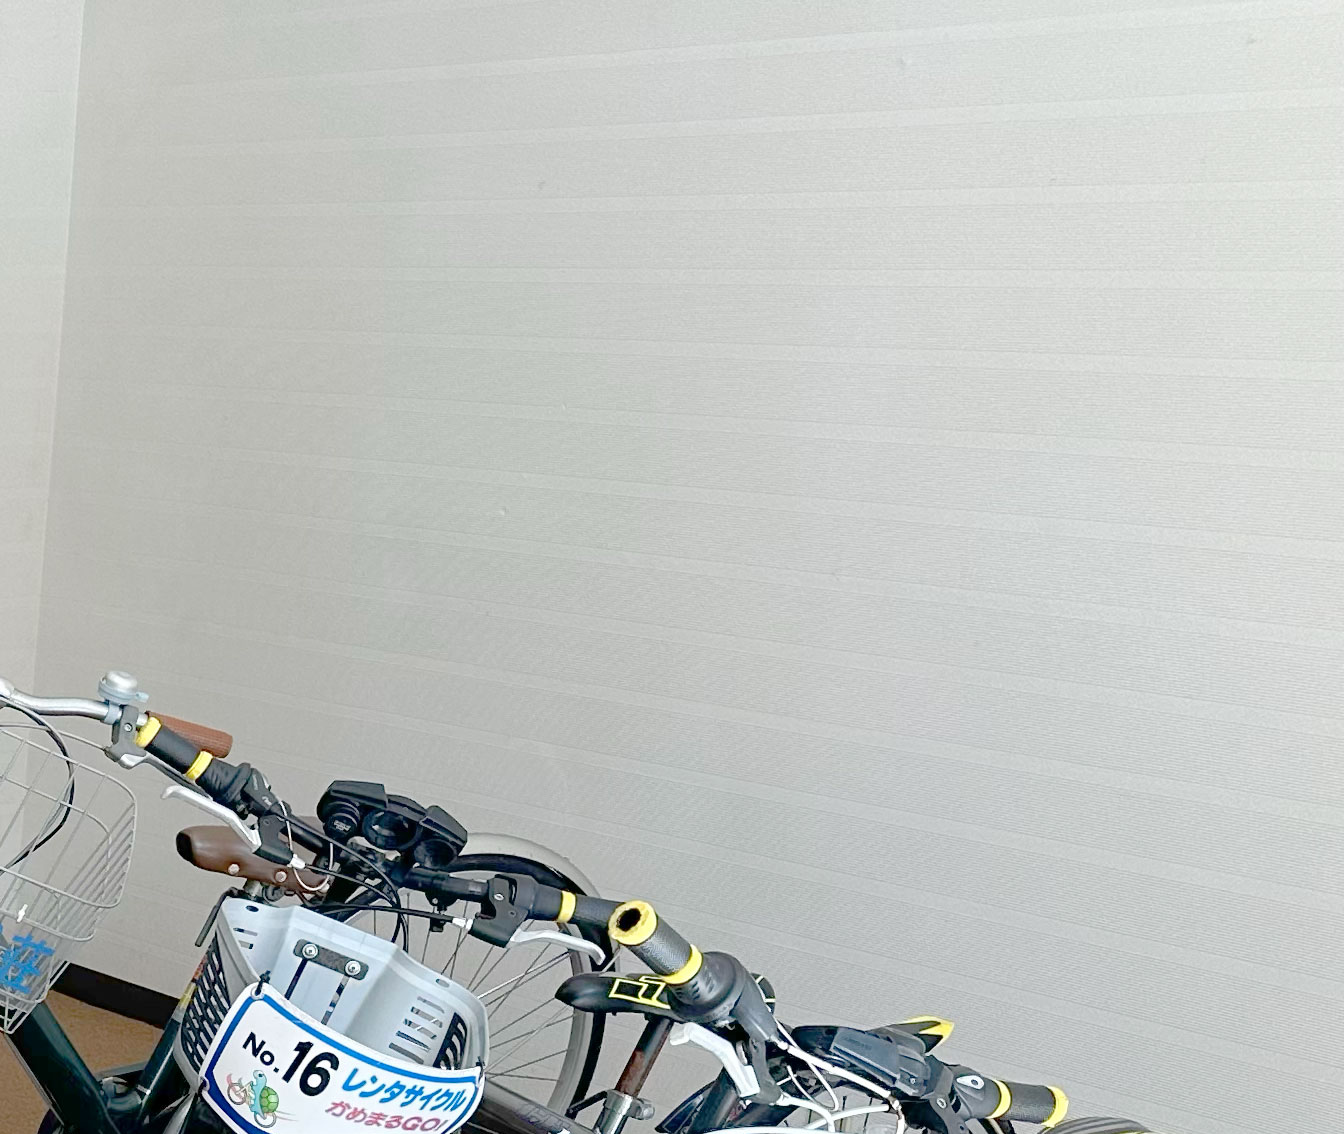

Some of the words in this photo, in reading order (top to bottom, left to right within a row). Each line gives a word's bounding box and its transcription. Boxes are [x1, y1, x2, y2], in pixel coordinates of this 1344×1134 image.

[341, 1067, 468, 1112] レンタサイクル
